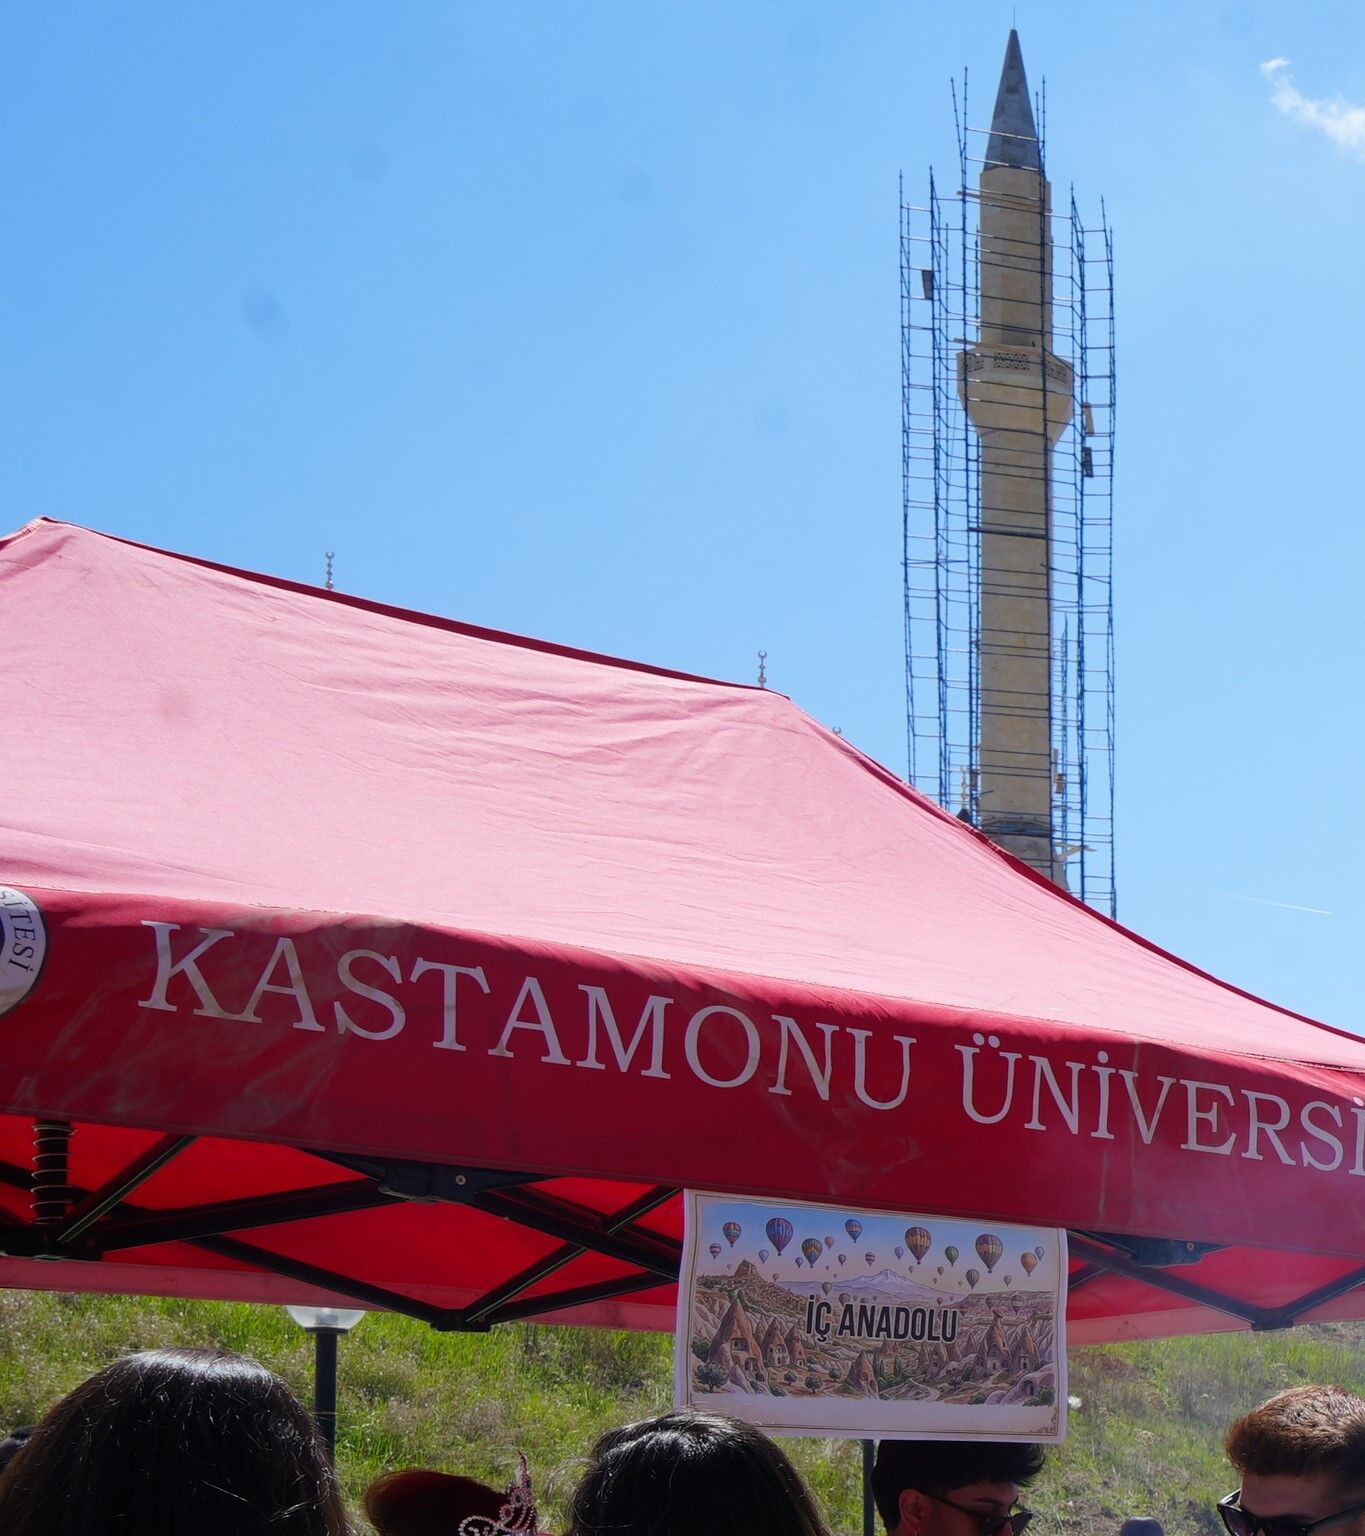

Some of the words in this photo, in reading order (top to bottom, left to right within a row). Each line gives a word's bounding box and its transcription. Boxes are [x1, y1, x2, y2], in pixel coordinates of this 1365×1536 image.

[138, 919, 917, 1110] KASTAMONU
[806, 1294, 832, 1342] İÇ
[838, 1303, 958, 1343] ANADOLU
